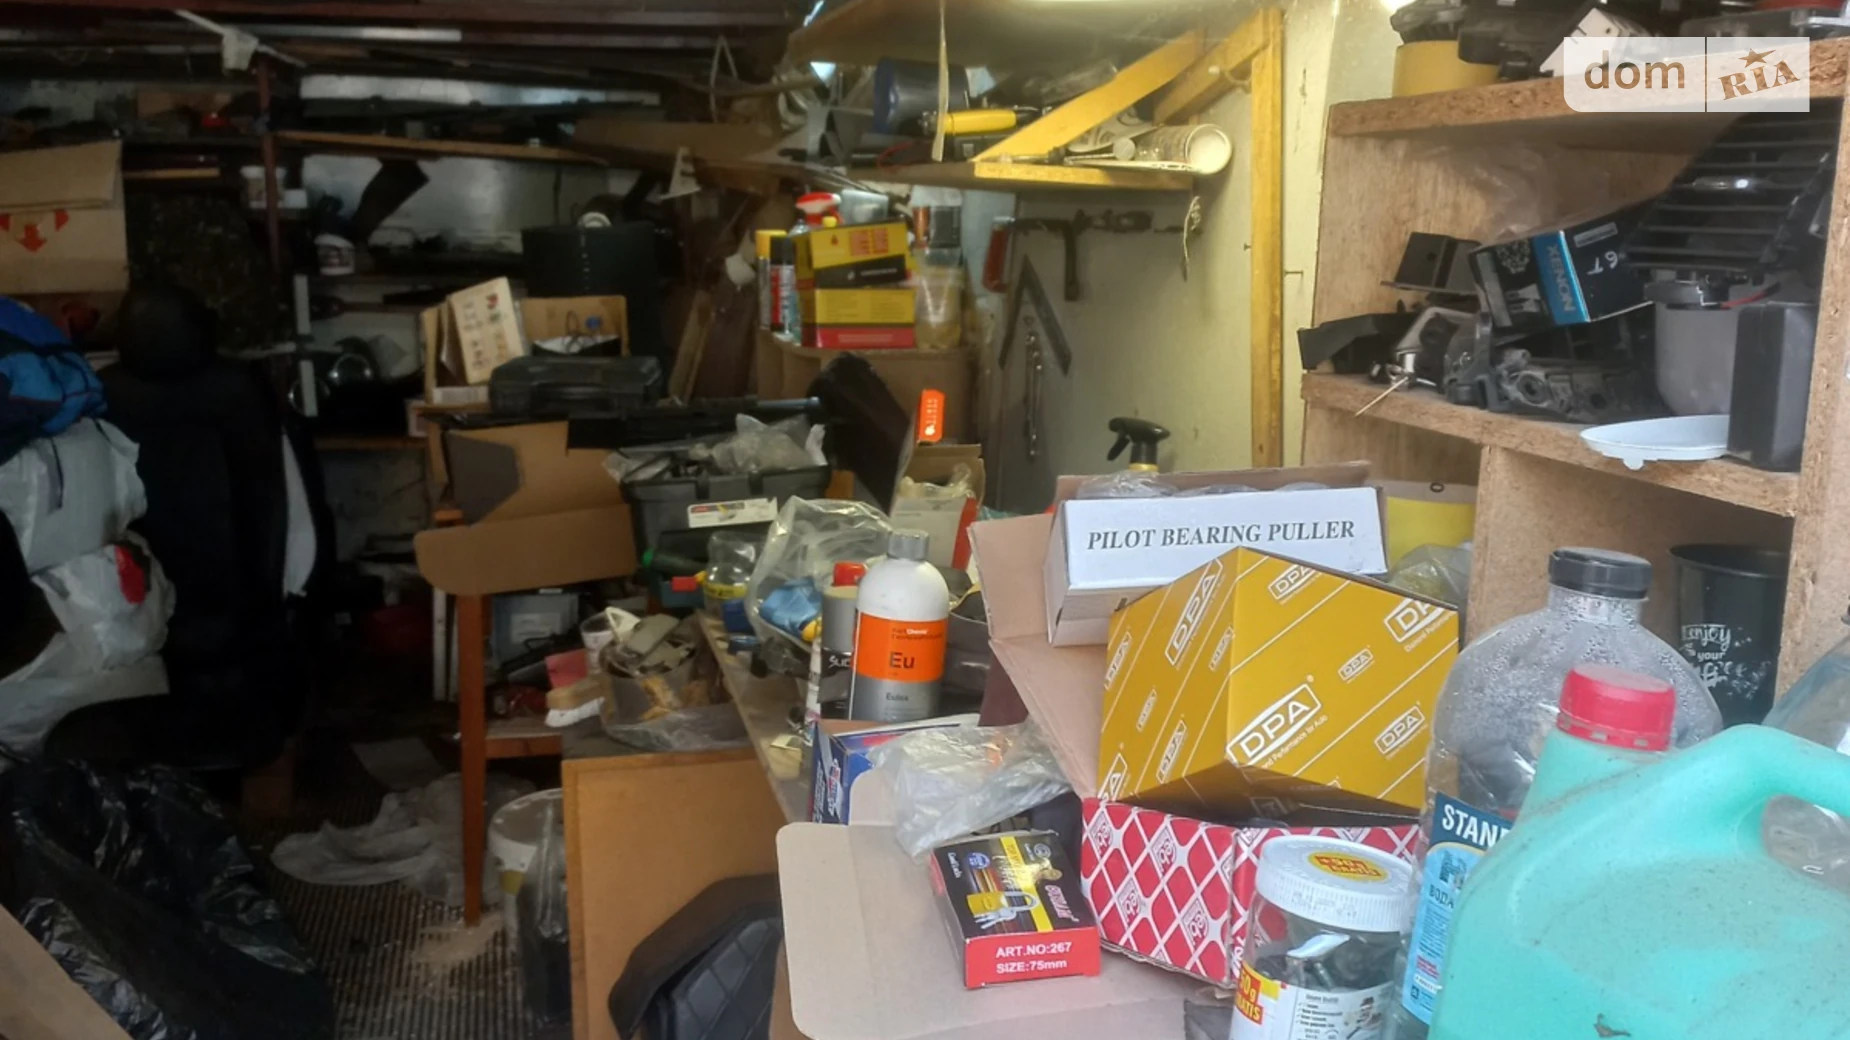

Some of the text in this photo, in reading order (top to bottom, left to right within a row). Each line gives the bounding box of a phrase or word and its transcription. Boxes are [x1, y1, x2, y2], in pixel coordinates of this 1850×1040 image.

[1547, 243, 1576, 312] XENON
[1087, 520, 1356, 550] PILOT BEARING PULLER
[1172, 574, 1217, 651] DPA
[889, 652, 915, 669] Eu
[1341, 654, 1370, 678] DPA
[1697, 651, 1726, 663] your
[1239, 700, 1311, 759] DPA
[1381, 715, 1420, 748] DPA
[995, 941, 1072, 958] ART.NO:267
[995, 959, 1067, 974] SIZE:75mm
